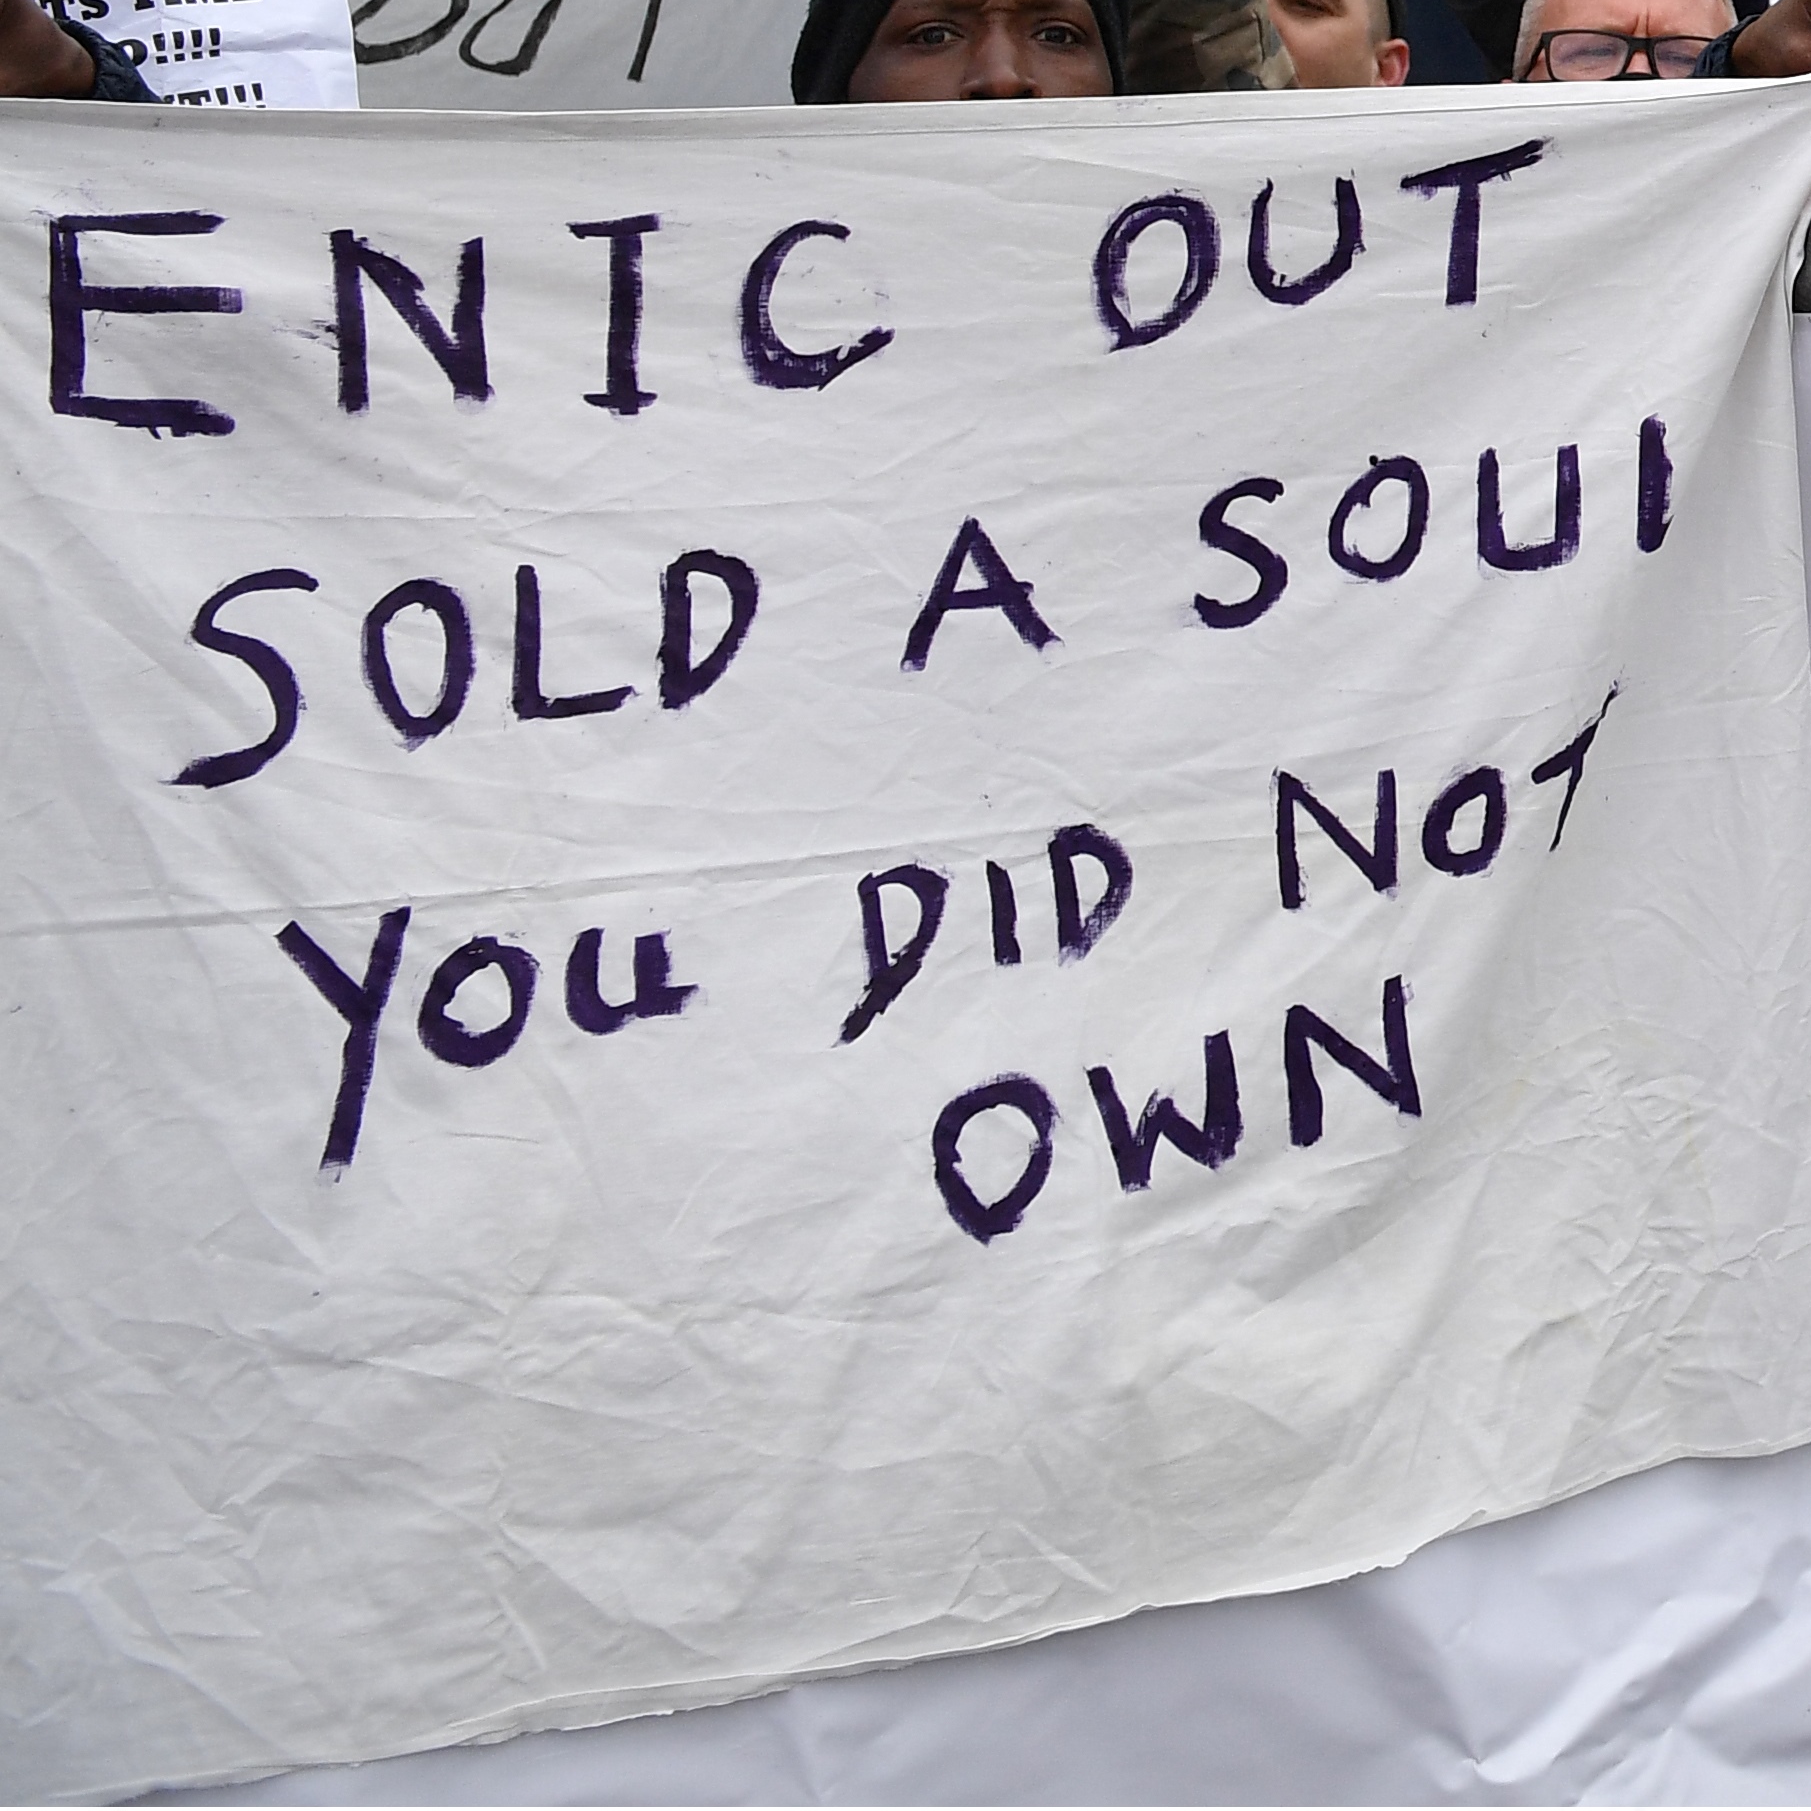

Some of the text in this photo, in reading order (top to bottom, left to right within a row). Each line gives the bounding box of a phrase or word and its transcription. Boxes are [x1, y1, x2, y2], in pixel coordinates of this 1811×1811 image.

[50, 139, 1550, 438] ENIC OUT
[165, 549, 759, 788] SOLD
[900, 516, 1065, 672] A
[839, 822, 1134, 1046] DID
[1275, 685, 1616, 910] NOT
[932, 975, 1421, 1244] OWN
